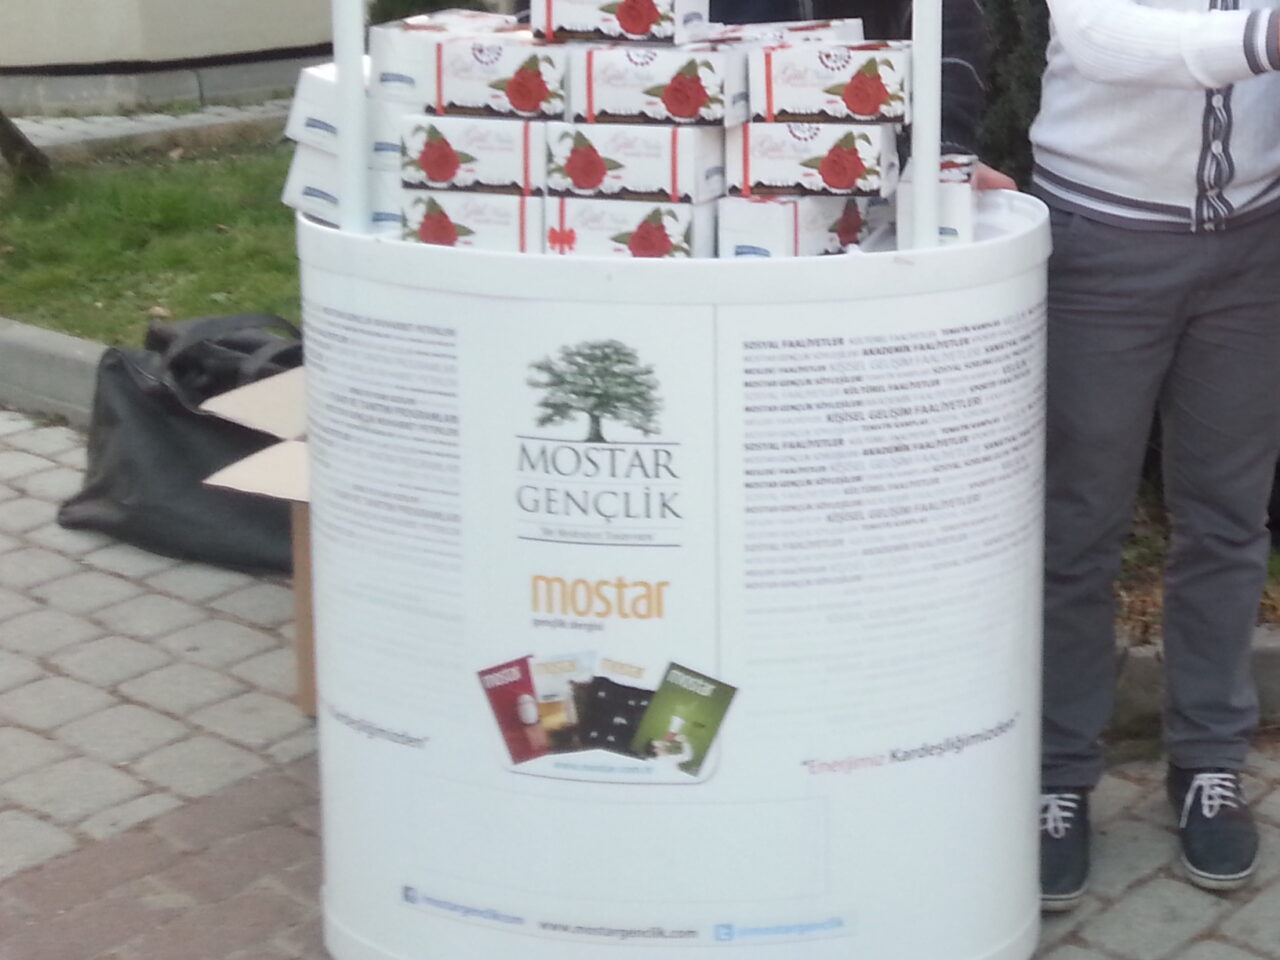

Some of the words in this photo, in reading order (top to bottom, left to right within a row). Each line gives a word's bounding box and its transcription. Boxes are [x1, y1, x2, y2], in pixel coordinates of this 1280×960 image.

[518, 442, 680, 479] MOSTAR
[516, 485, 682, 523] GENÇLİK
[530, 574, 671, 620] mostar
